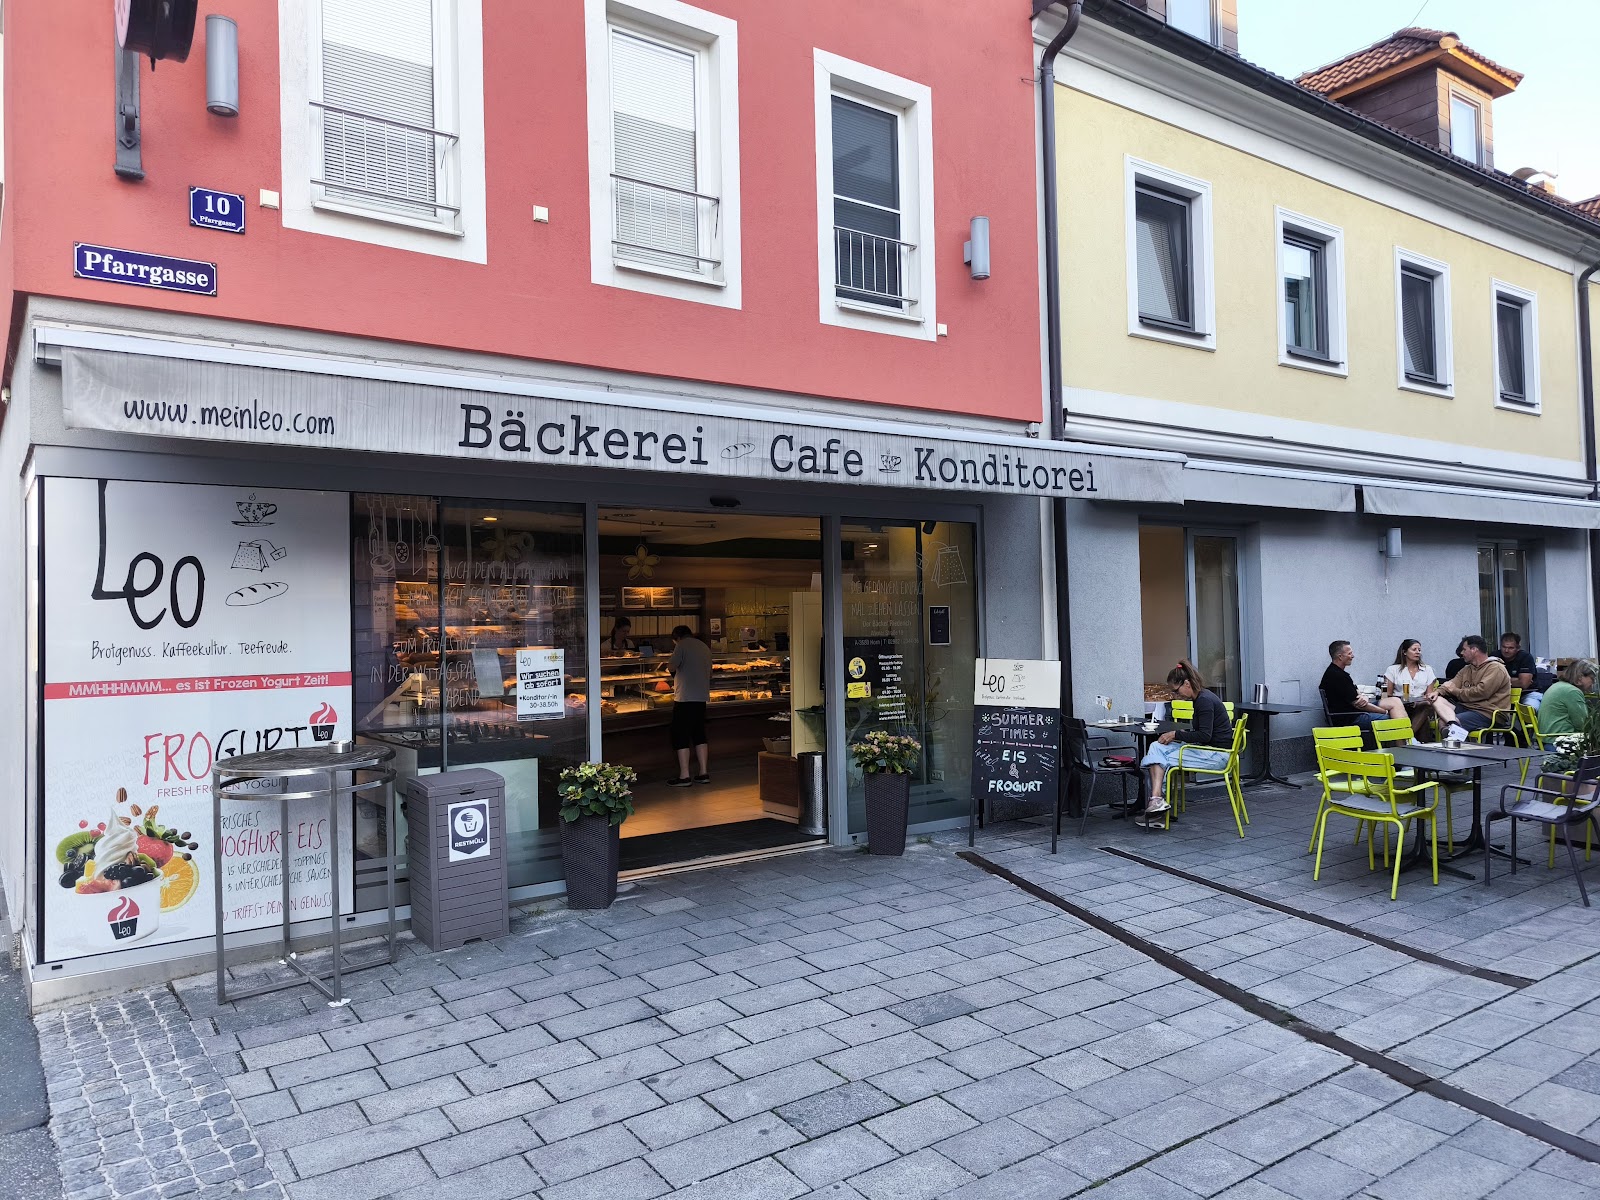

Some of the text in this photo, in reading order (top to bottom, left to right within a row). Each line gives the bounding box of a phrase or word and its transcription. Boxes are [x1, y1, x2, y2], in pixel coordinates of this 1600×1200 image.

[205, 195, 230, 215] 10
[200, 215, 236, 227] Pfarrgasse
[83, 250, 209, 288] Pfarrgasse
[124, 399, 335, 435] www.meinleo.com
[458, 403, 1098, 492] Bäckerei Cafe Konditorei
[91, 479, 206, 630] Leo
[91, 640, 292, 666] Brotgenuss. Kaffeekultur. Teefreude.
[392, 637, 417, 654] ZUM
[370, 664, 383, 684] IN
[388, 664, 409, 683] DER
[521, 668, 559, 680] Wir suchen
[982, 658, 1006, 693] Leo
[176, 683, 191, 692] es
[194, 680, 210, 690] ist
[213, 678, 257, 690] Frozen
[260, 675, 301, 690] Yogurt
[304, 675, 329, 686] Zeit!
[536, 679, 559, 688] sofort
[991, 712, 1045, 727] SUMMER
[1000, 727, 1036, 740] TIMES
[1001, 749, 1027, 764] EIS
[157, 777, 290, 798] FRESH FREN YOGUT
[987, 780, 1043, 793] FROGURT
[220, 819, 327, 857] JOGHUR EIS
[454, 837, 485, 848] RESTMÜLL
[237, 858, 290, 875] VERSCHIEDE
[266, 896, 297, 915] DEINN
